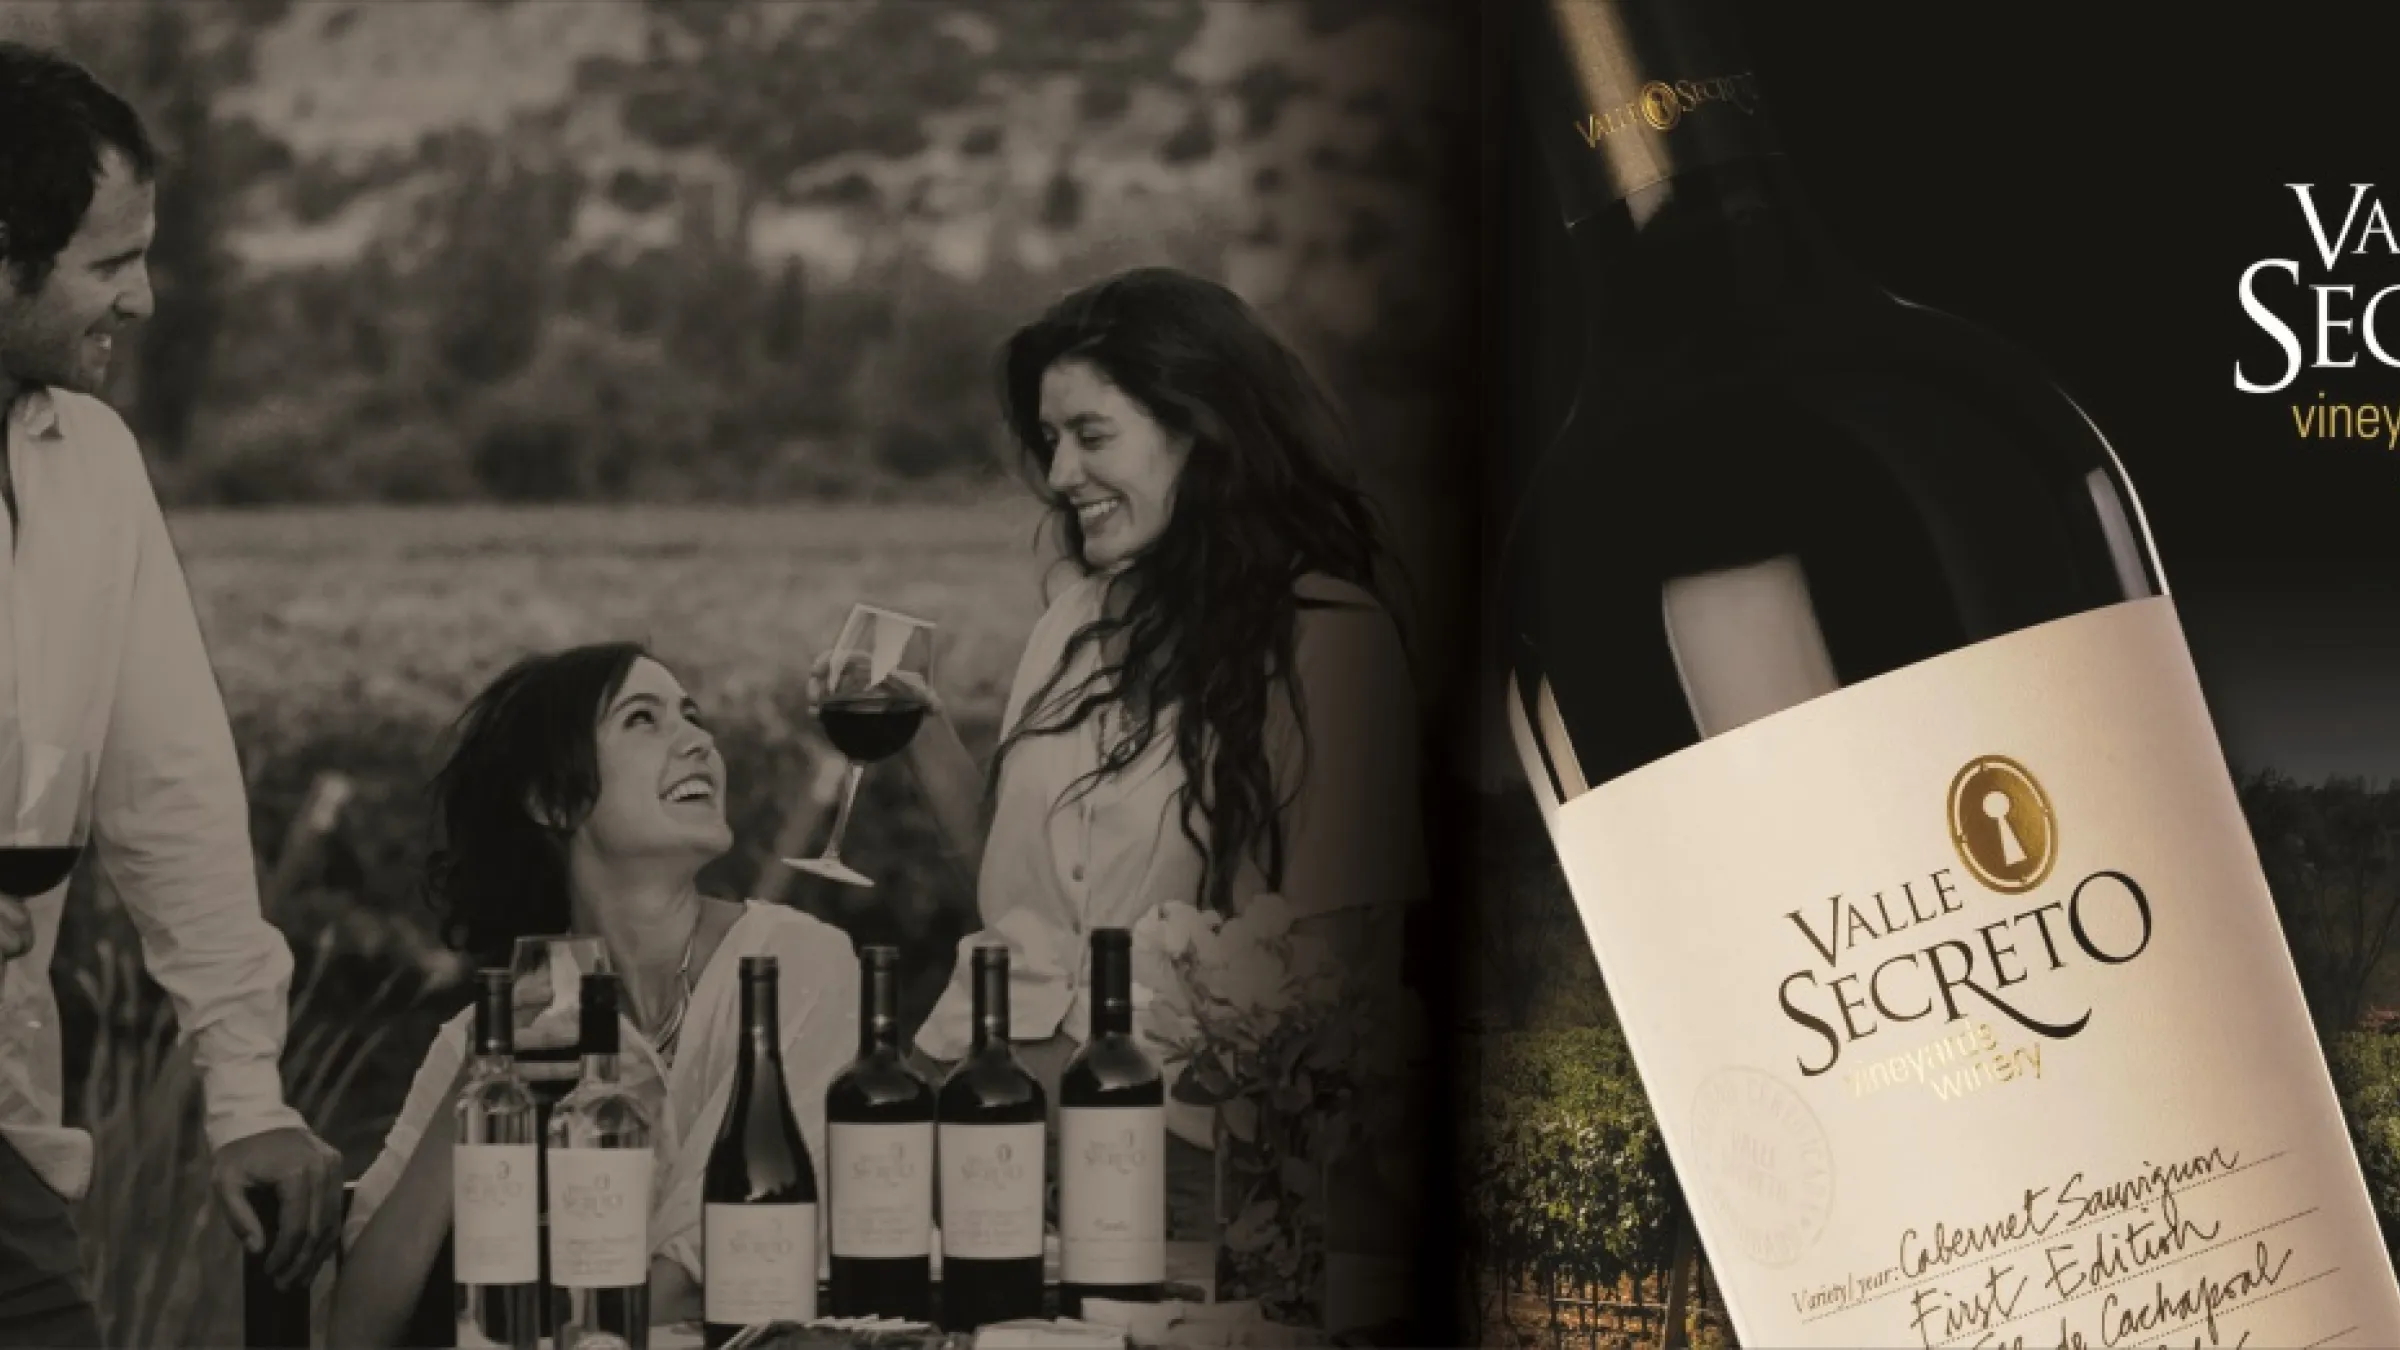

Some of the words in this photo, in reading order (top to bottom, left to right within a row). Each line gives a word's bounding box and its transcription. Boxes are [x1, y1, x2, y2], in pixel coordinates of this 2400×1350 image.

[1783, 868, 1963, 967] VALLE
[1779, 870, 2152, 1077] SECRETO
[1844, 1020, 1997, 1097] vineyards
[1931, 1043, 2042, 1101] winery
[1900, 1187, 2058, 1278] Cabernet
[2058, 1147, 2239, 1233] Sauvignon
[1910, 1265, 2028, 1348] First
[2045, 1207, 2220, 1298] Edition
[2102, 1241, 2293, 1347] Cachapoal
